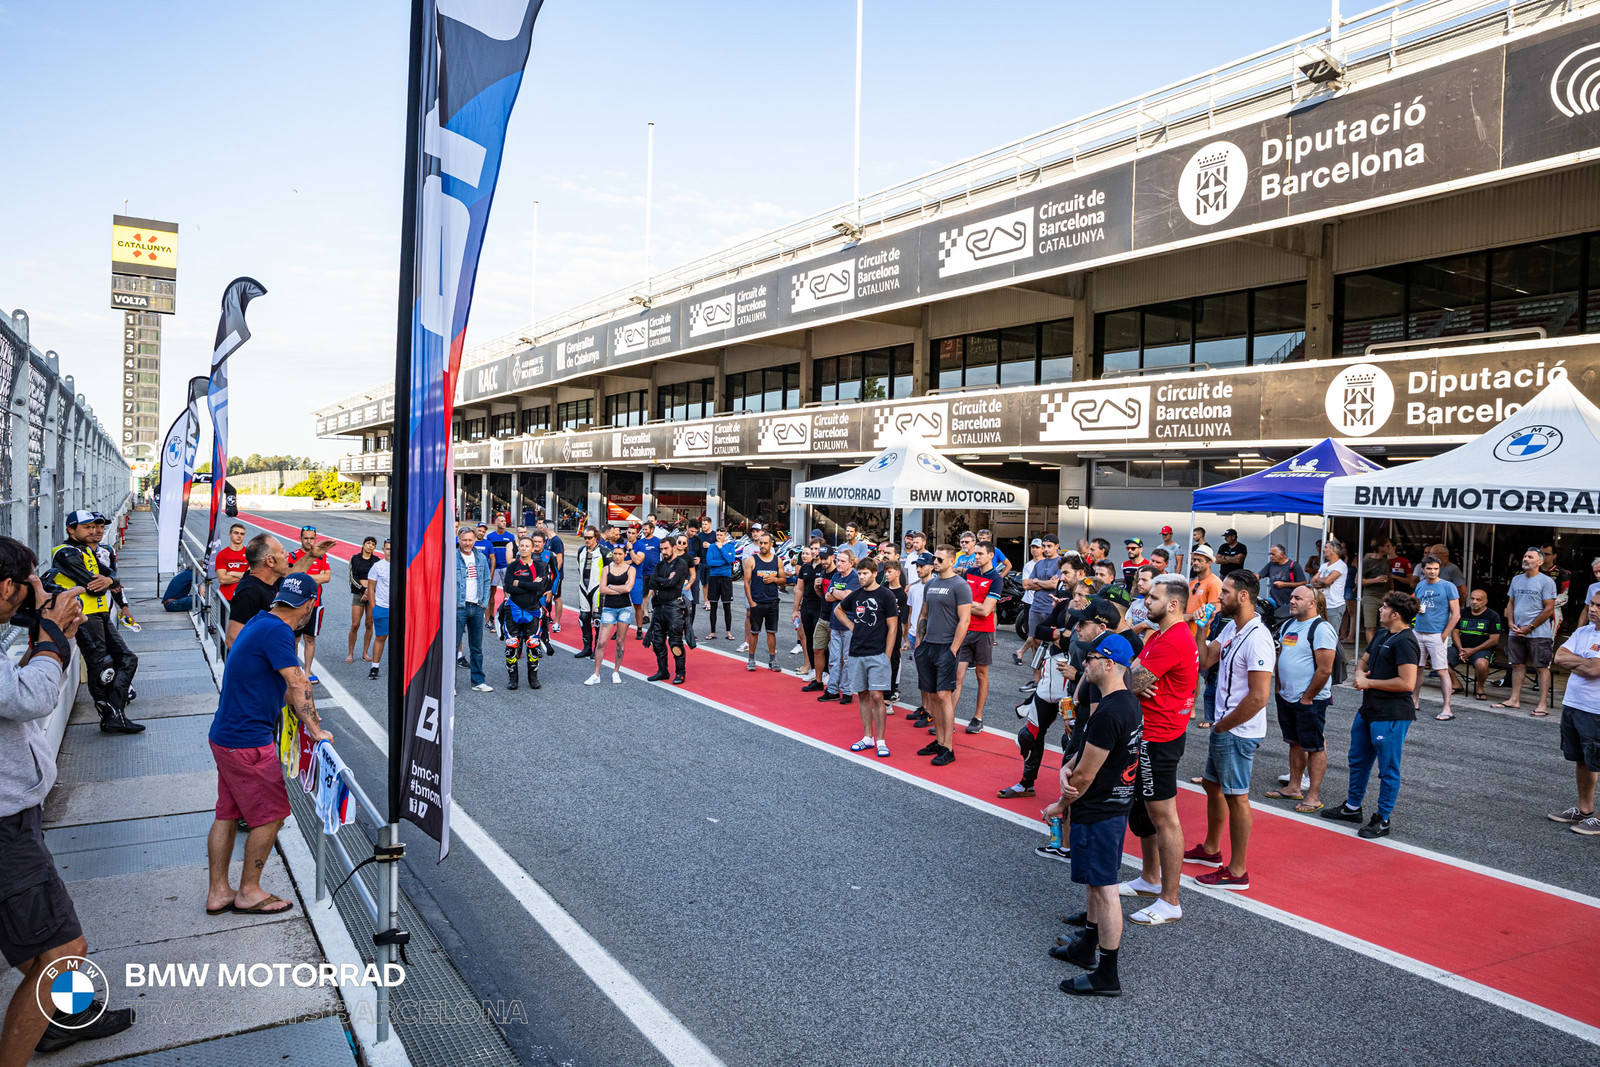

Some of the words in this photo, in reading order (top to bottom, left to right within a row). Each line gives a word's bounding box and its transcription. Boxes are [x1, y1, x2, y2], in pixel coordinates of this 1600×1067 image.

[1261, 95, 1426, 166] Diputació
[1261, 142, 1426, 201] Barcelona
[1039, 193, 1085, 220] Circuit
[1087, 189, 1105, 207] de
[1039, 209, 1105, 238] Barcelona
[117, 240, 172, 253] CATALUNYA
[1039, 227, 1105, 254] CATALUNYA
[858, 250, 888, 270] Circuit
[888, 248, 900, 261] de
[857, 264, 900, 284] Barcelona
[737, 286, 757, 303] Circuit
[757, 285, 767, 296] de
[857, 278, 900, 298] CATALUNYA
[113, 294, 148, 306] VOLTA
[736, 299, 767, 315] Barcelona
[127, 315, 134, 324] 1
[649, 314, 664, 327] Circuit
[664, 313, 672, 323] de
[736, 311, 767, 326] CATALUNYA
[125, 329, 134, 339] 2
[649, 325, 671, 338] Barcelona
[125, 344, 134, 353] 3
[566, 335, 594, 353] Generalitat
[125, 359, 134, 368] 4
[566, 358, 574, 368] de
[574, 351, 600, 367] Catalunya
[125, 373, 134, 383] 5
[478, 365, 499, 393] RACC
[1407, 360, 1569, 398] Diputació
[125, 388, 133, 397] 6
[1156, 383, 1211, 403] Circuit
[1213, 380, 1234, 398] de
[125, 402, 133, 412] 7
[952, 400, 986, 416] Circuit
[987, 398, 1002, 413] de
[1156, 402, 1233, 421] Barcelona
[1407, 398, 1523, 426] Barcelo
[125, 417, 133, 426] 8
[814, 414, 838, 425] Circuit
[839, 412, 850, 424] de
[951, 416, 1002, 431] Barcelona
[714, 424, 732, 434] Circuit
[732, 423, 741, 432] de
[813, 427, 849, 439] Barcelona
[1155, 421, 1232, 439] CATALUNYA
[1510, 427, 1557, 440] BMW
[124, 431, 133, 441] 9
[622, 432, 651, 445] Generalitat
[713, 434, 740, 445] Barcelona
[951, 430, 1002, 445] CATALUNYA
[522, 440, 544, 464] RACC
[622, 447, 629, 457] de
[629, 445, 656, 459] Catalunya
[713, 445, 741, 455] CATALUNYA
[813, 439, 849, 451] CATALUNYA
[193, 473, 212, 483] MC
[804, 487, 827, 499] BMW
[828, 487, 881, 500] MOTORRAD
[910, 489, 943, 502] BMW
[946, 490, 1015, 503] MOTORRAD
[1354, 485, 1424, 508] BMW
[1431, 487, 1600, 514] MOTORRA
[1068, 498, 1080, 509] 36
[283, 578, 302, 586] BMW
[1141, 766, 1155, 797] CALVIN
